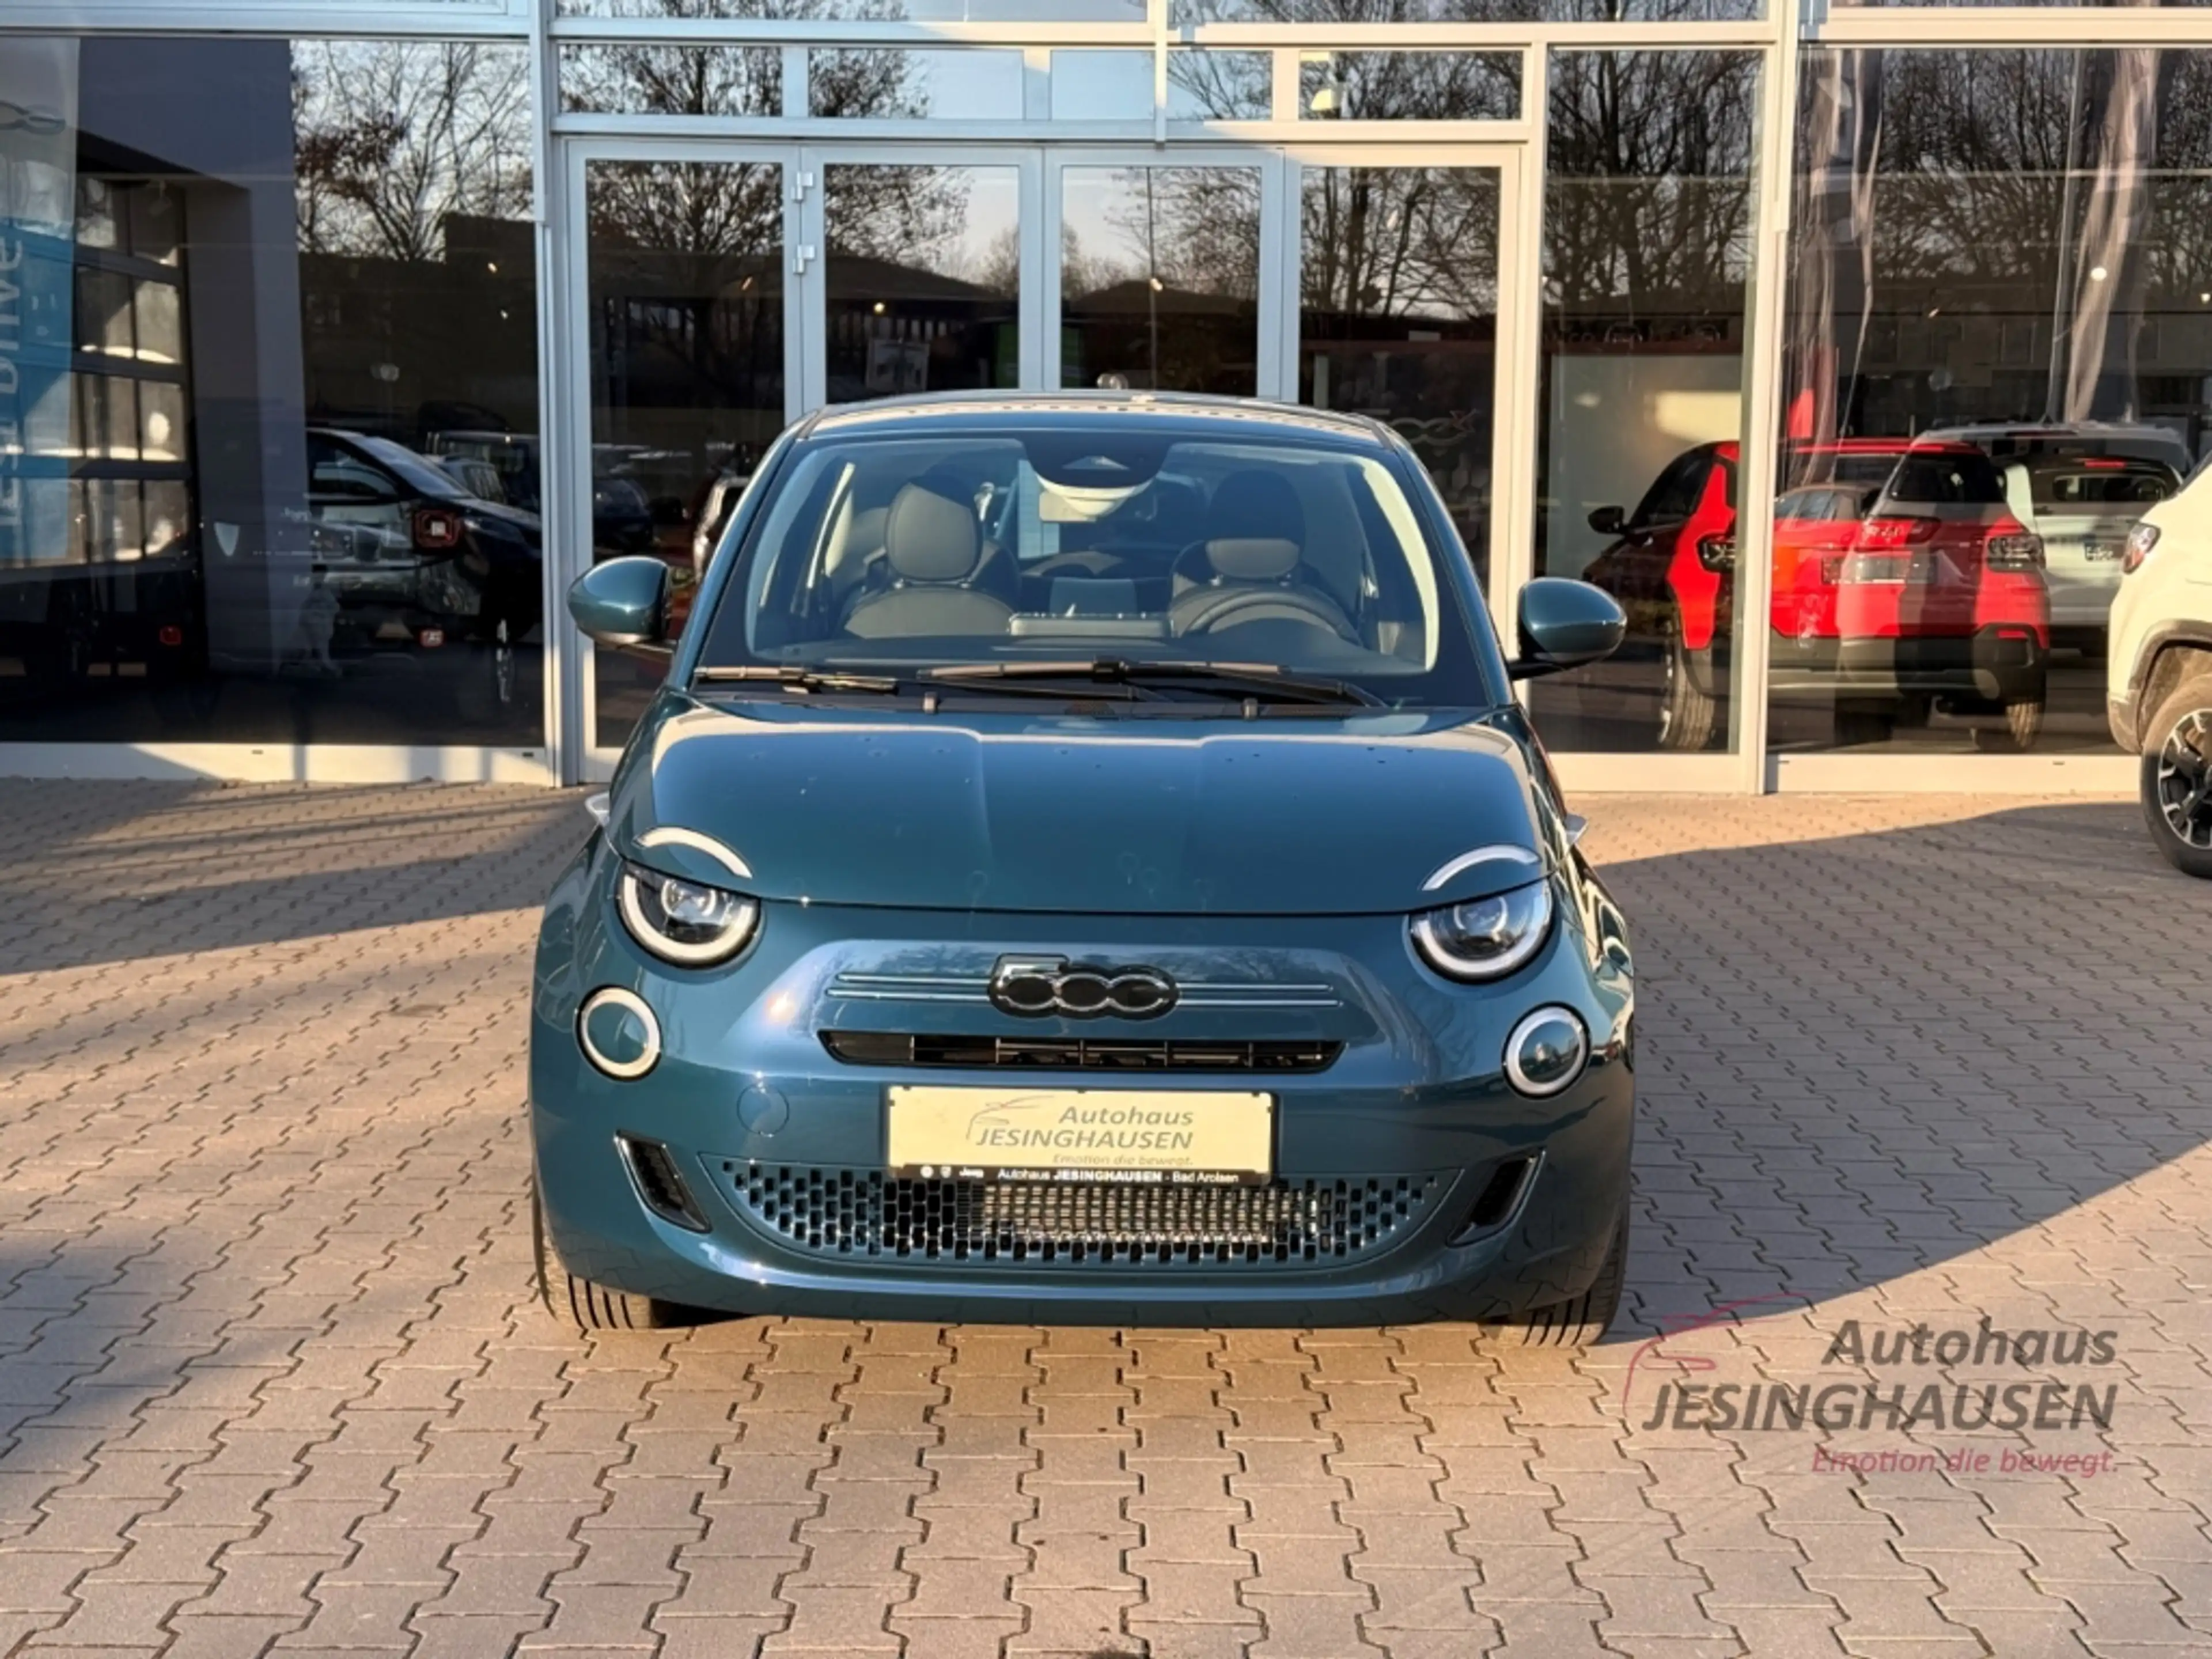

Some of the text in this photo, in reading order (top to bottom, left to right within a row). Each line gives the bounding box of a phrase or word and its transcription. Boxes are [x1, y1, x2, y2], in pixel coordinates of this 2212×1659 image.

[990, 953, 1179, 1019] 500
[1058, 1105, 1194, 1126] Autohaus
[976, 1128, 1194, 1150] JESINGHAUSEN
[1052, 1154, 1111, 1165] Emotion
[1113, 1154, 1135, 1165] die
[997, 1168, 1050, 1180] Autohaus
[1053, 1169, 1162, 1182] JESINGHAUSEN
[1172, 1171, 1195, 1183] Bad
